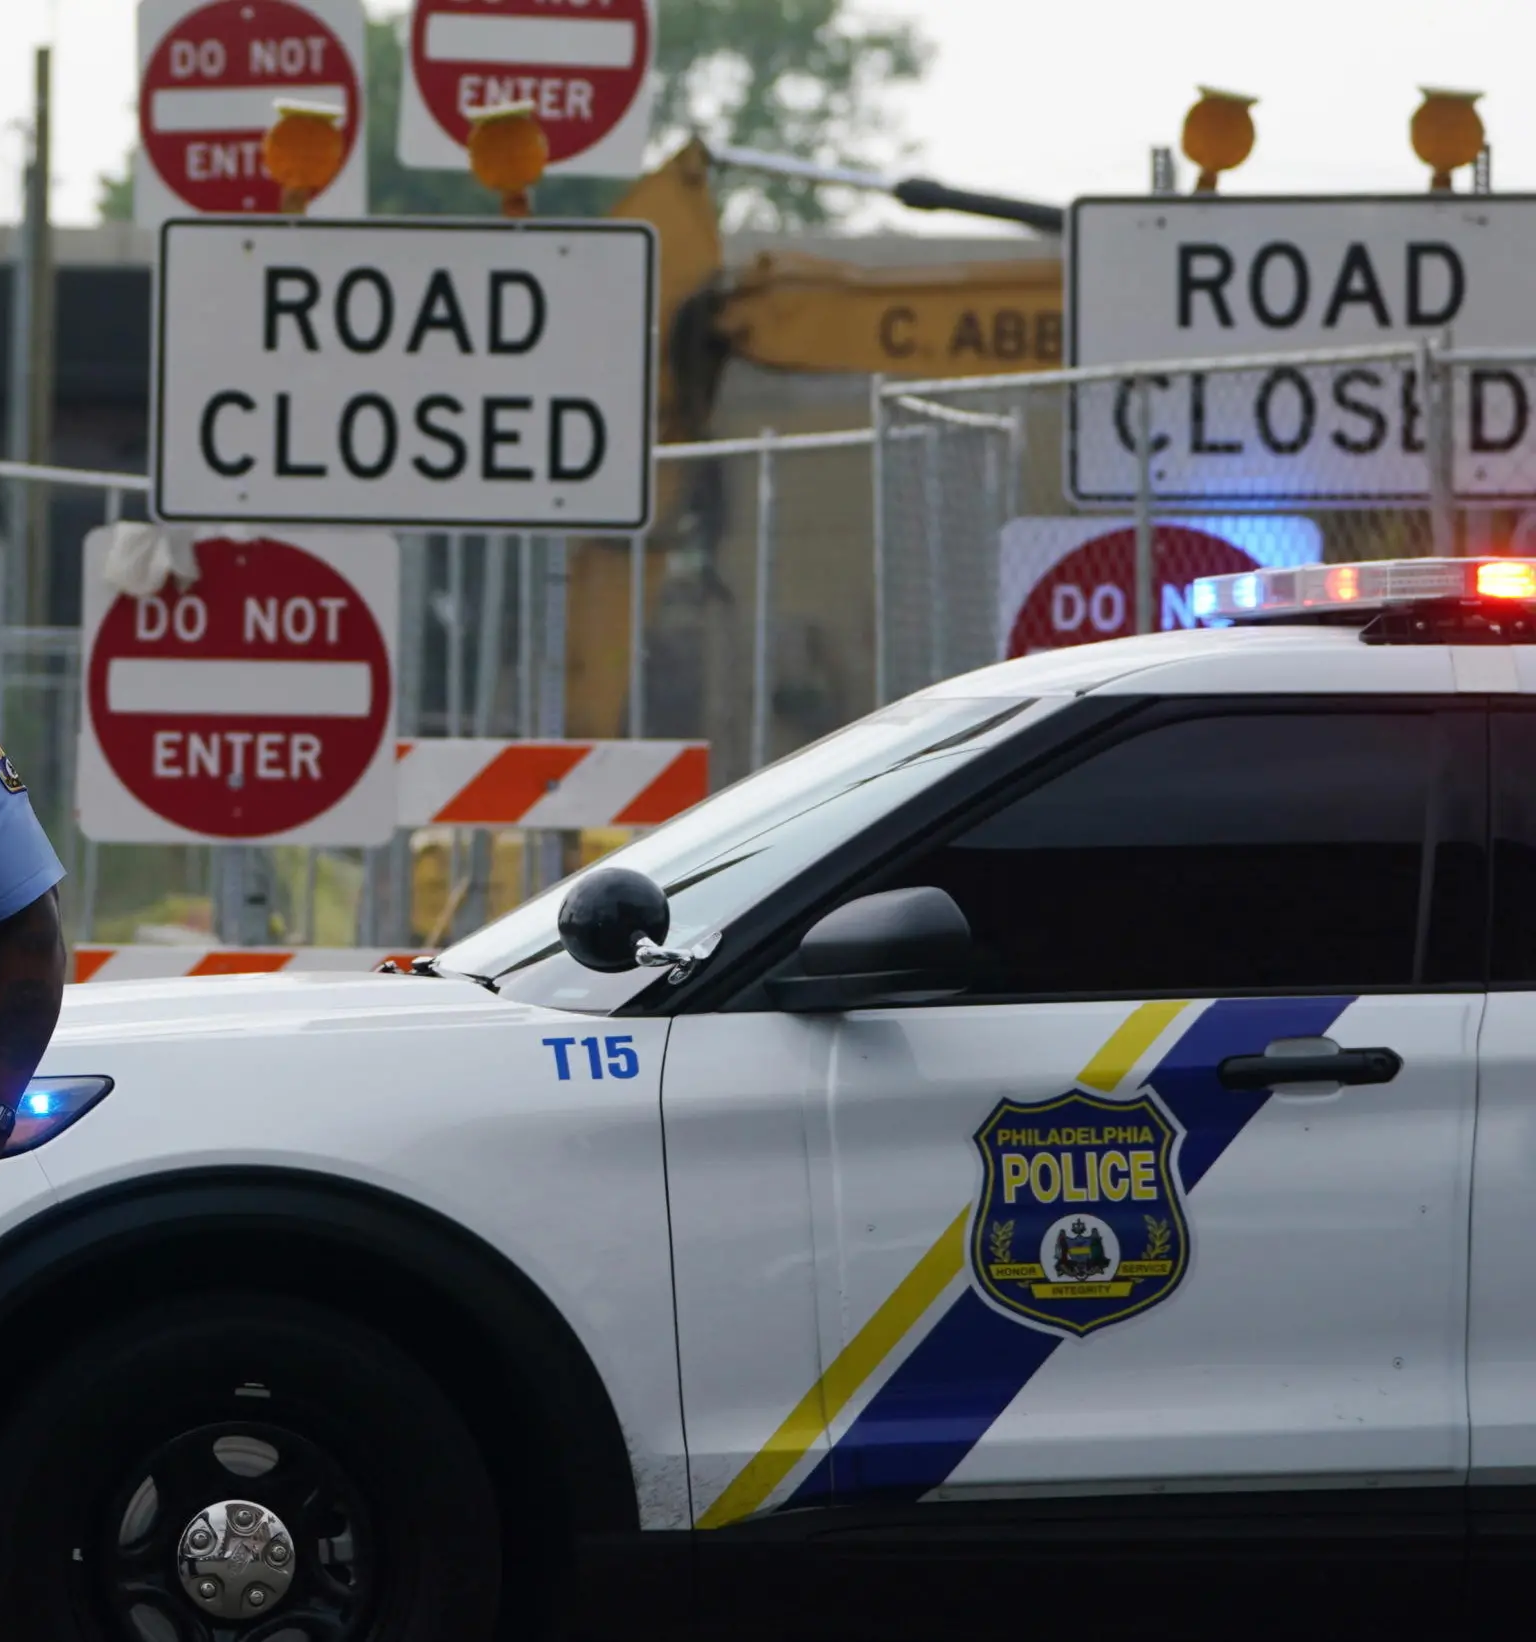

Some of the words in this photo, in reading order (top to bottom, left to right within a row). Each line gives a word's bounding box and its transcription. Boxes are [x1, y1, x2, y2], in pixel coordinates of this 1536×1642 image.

[170, 38, 227, 79] DO
[248, 35, 328, 77] NOT
[457, 73, 595, 123] ENTER
[186, 141, 271, 182] ENT
[1176, 241, 1466, 329] ROAD
[263, 266, 547, 355] ROAD
[199, 389, 607, 482] CLOSED
[135, 596, 207, 642] DO
[243, 596, 347, 644] NOT
[1051, 583, 1126, 632] DO
[152, 732, 323, 781] ENTER
[541, 1035, 640, 1081] T15
[996, 1126, 1155, 1146] PHILADELPHIA
[1001, 1150, 1158, 1204] POLICE
[995, 1266, 1037, 1277] HONOR
[1121, 1263, 1169, 1274] SERVICE
[1051, 1284, 1112, 1296] INTEGRITY
